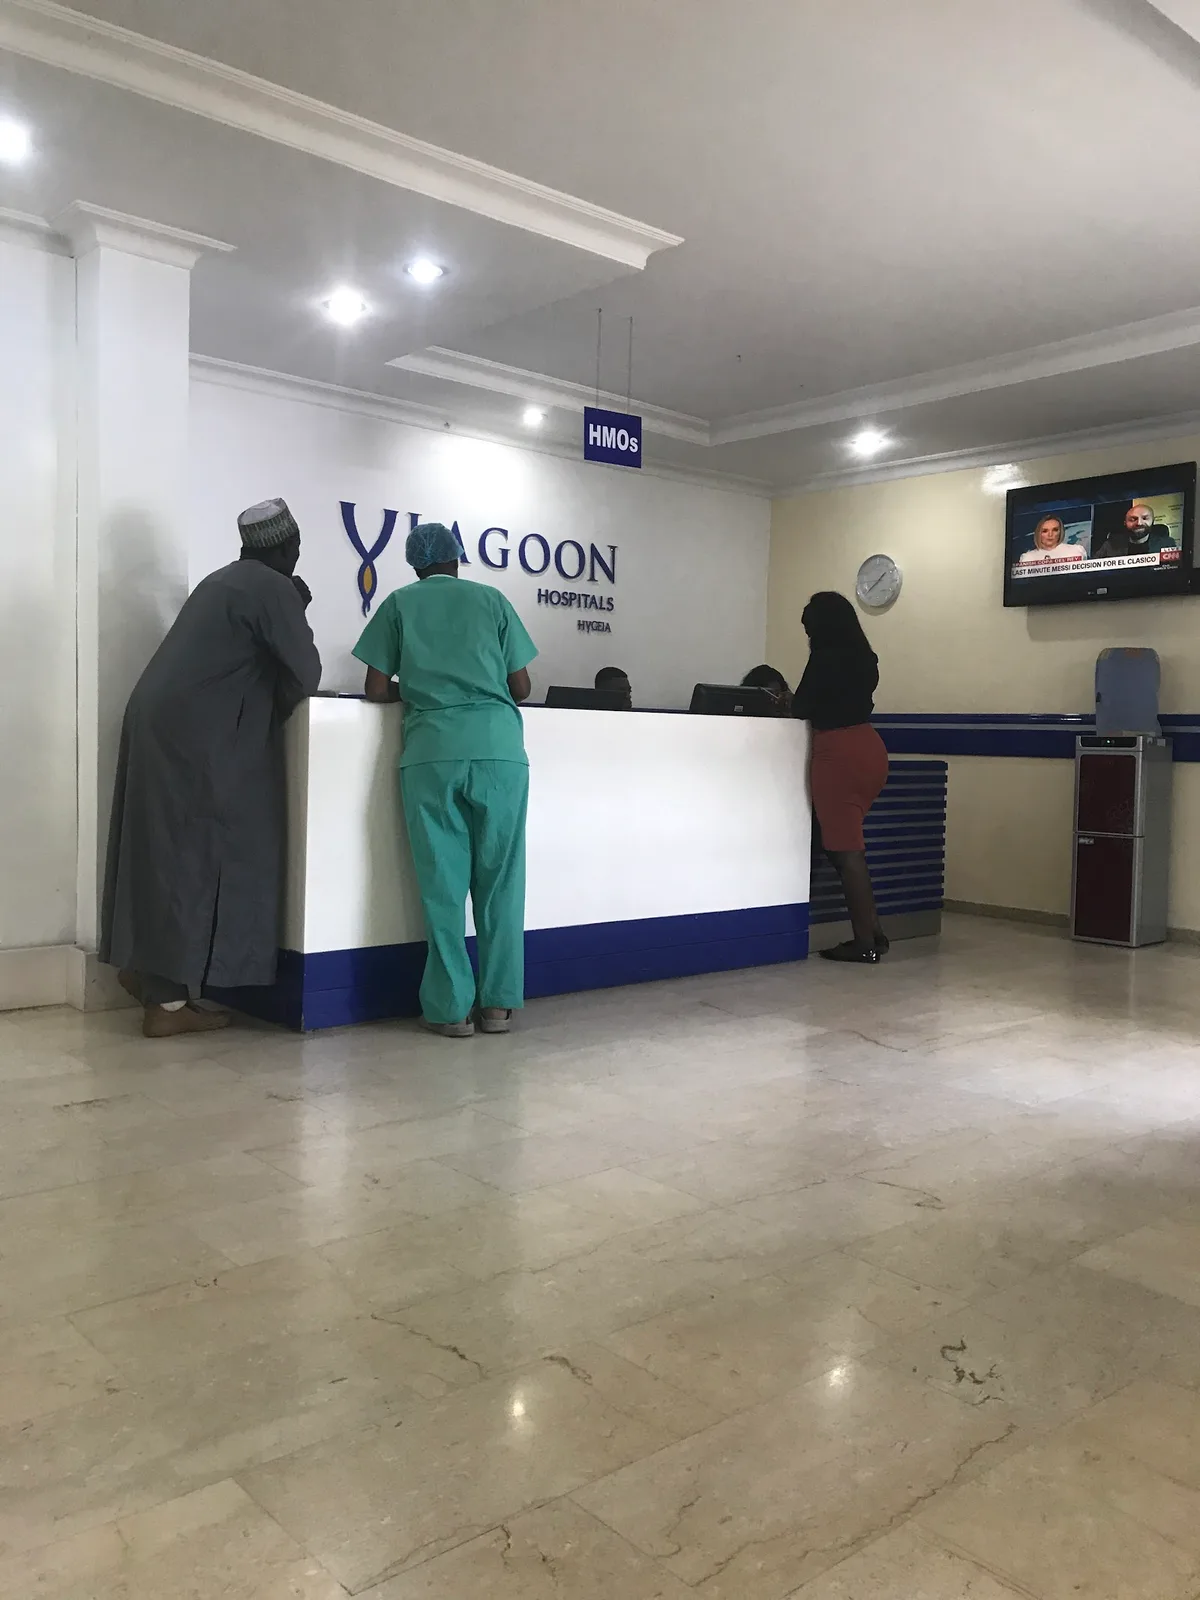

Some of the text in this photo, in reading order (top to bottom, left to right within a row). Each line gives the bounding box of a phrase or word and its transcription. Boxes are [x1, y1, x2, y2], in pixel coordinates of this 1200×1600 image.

[589, 423, 639, 453] HMOs
[1027, 566, 1051, 575] MINUTE
[1052, 564, 1070, 573] MESSI
[1072, 561, 1101, 570] DECISION
[1103, 559, 1117, 567] FOR
[1127, 556, 1157, 565] CLASICO
[537, 588, 615, 612] HOSPITALS
[577, 620, 611, 634] HYGEIA
